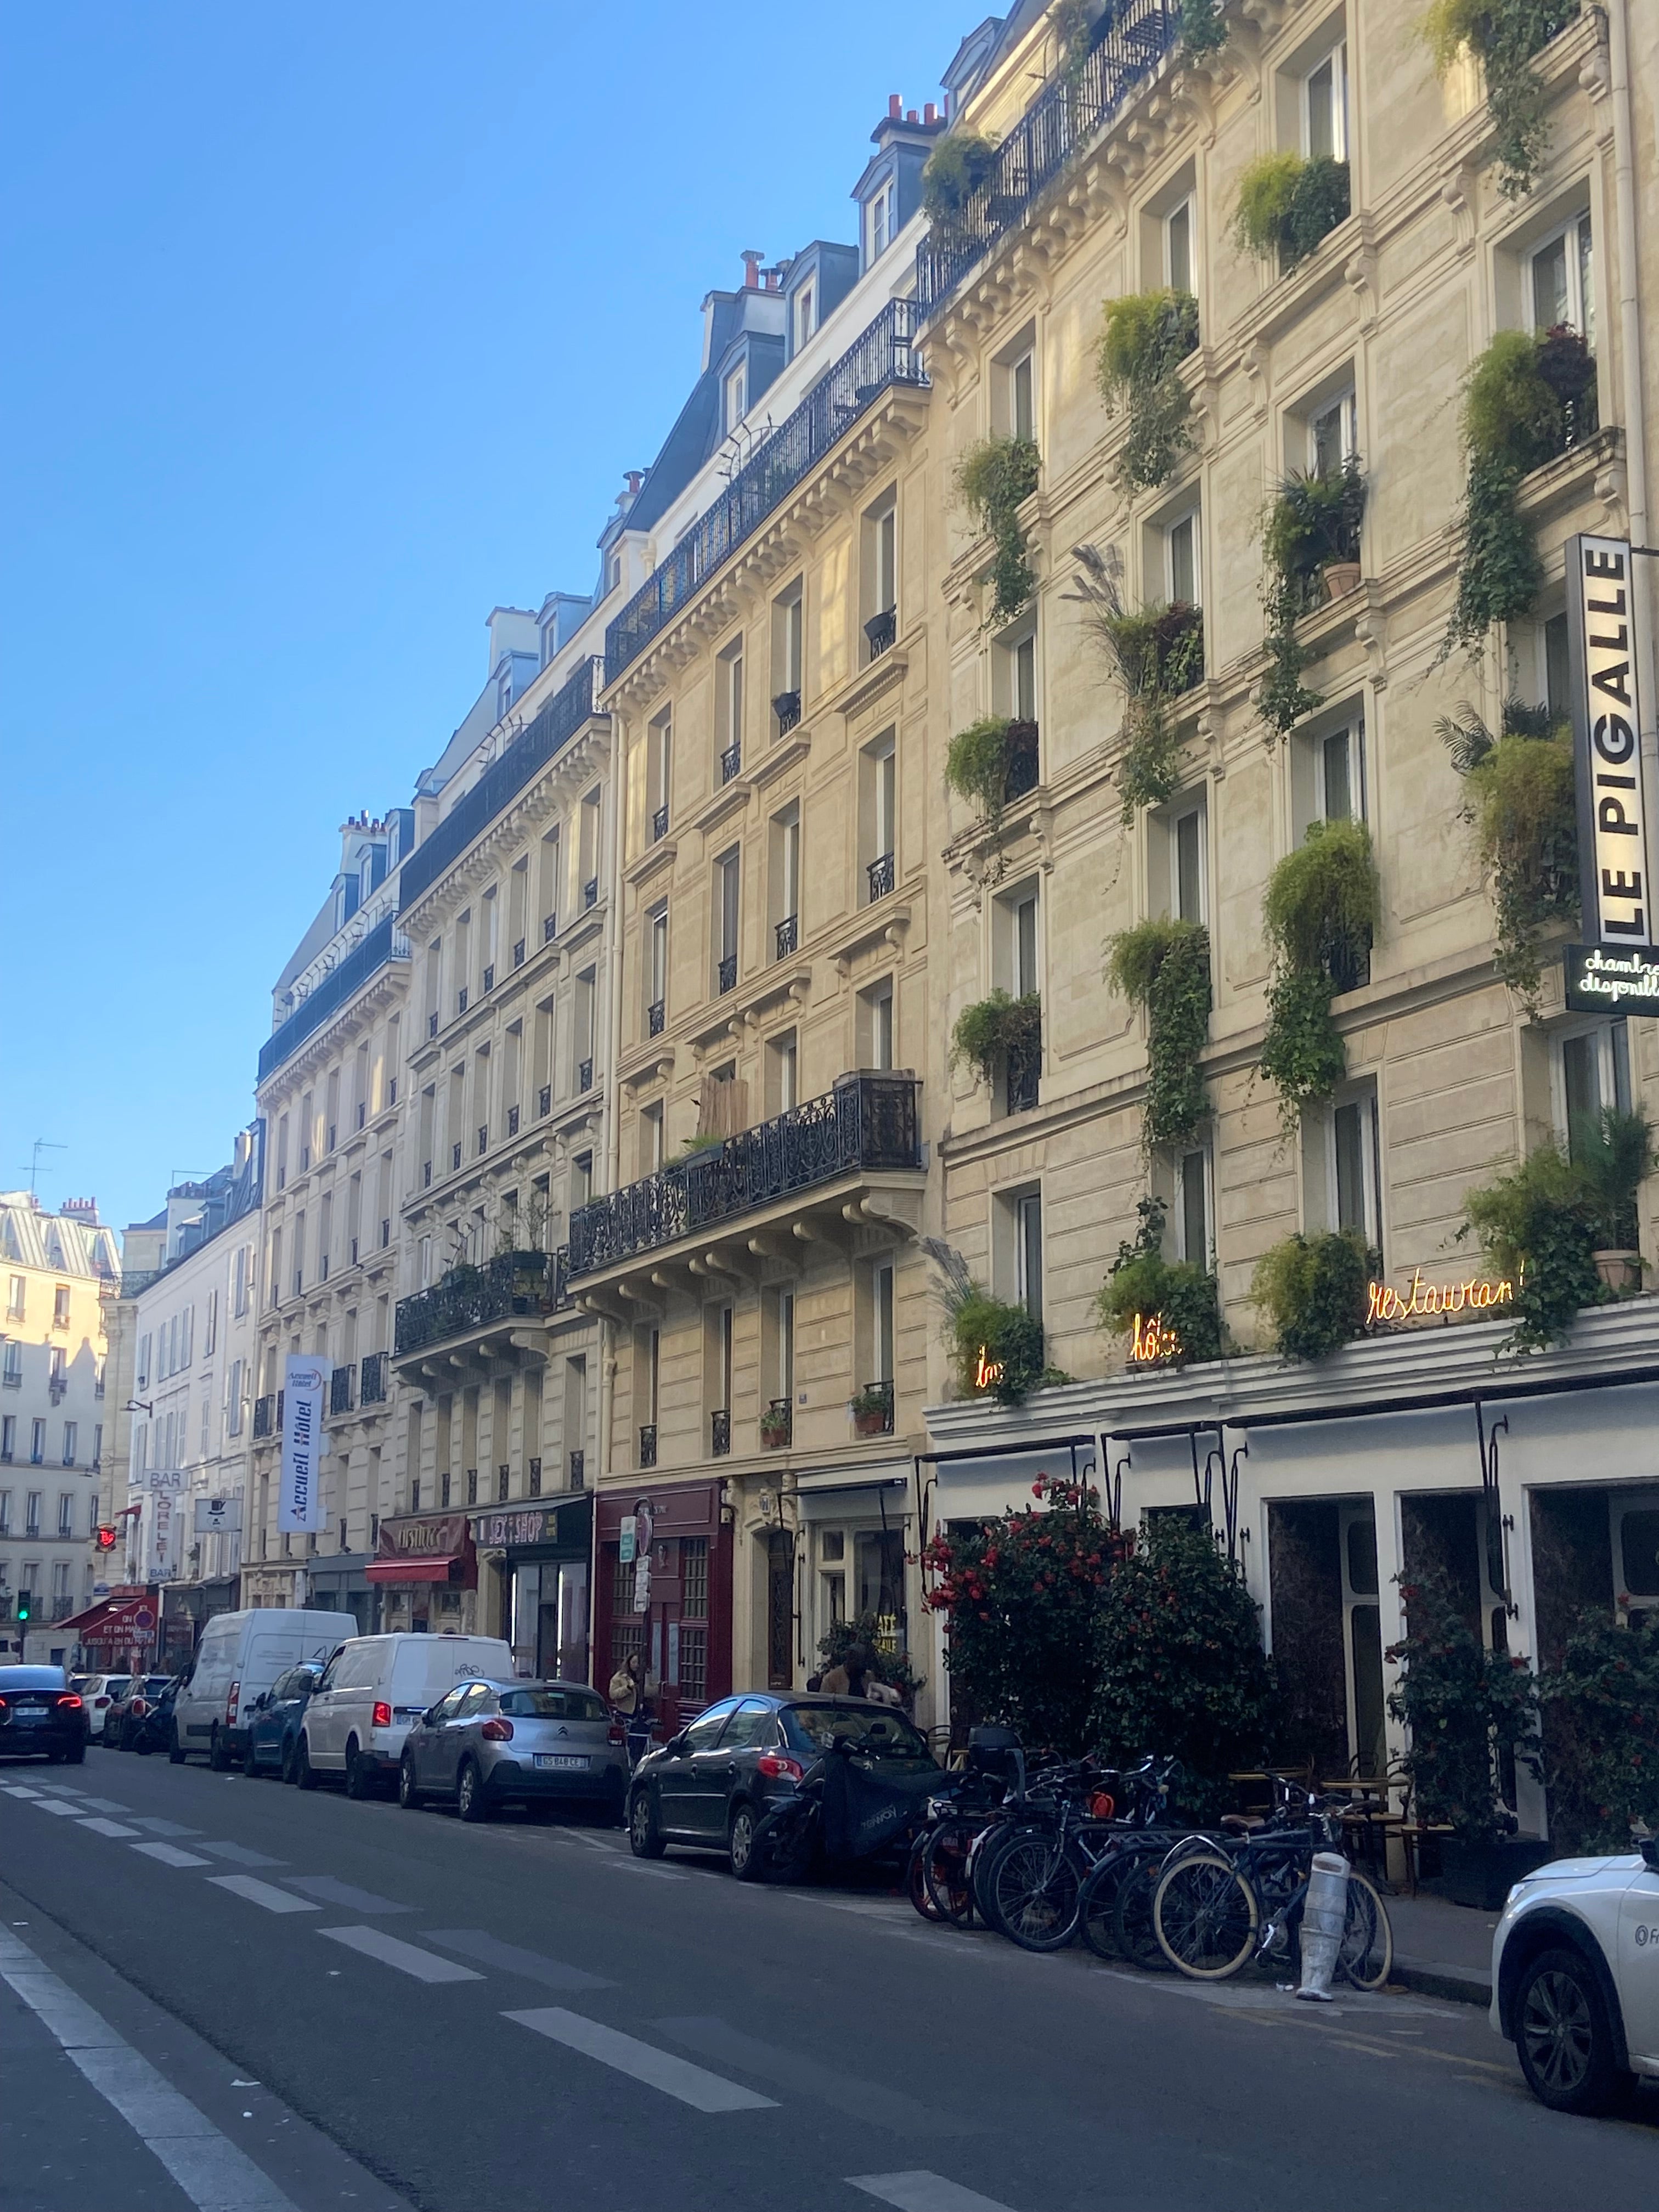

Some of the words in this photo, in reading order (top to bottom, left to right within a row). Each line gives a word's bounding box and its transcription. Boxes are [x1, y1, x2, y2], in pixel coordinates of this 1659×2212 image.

[1584, 550, 1639, 836] PIGALLE
[1602, 868, 1645, 936] LE
[294, 1400, 312, 1447] Hôtel
[150, 1472, 181, 1487] BAR
[290, 1452, 309, 1522] Accueil
[514, 1511, 543, 1544] SHOP
[150, 1569, 172, 1577] BAR
[103, 1626, 113, 1634] ET
[114, 1626, 123, 1634] ON
